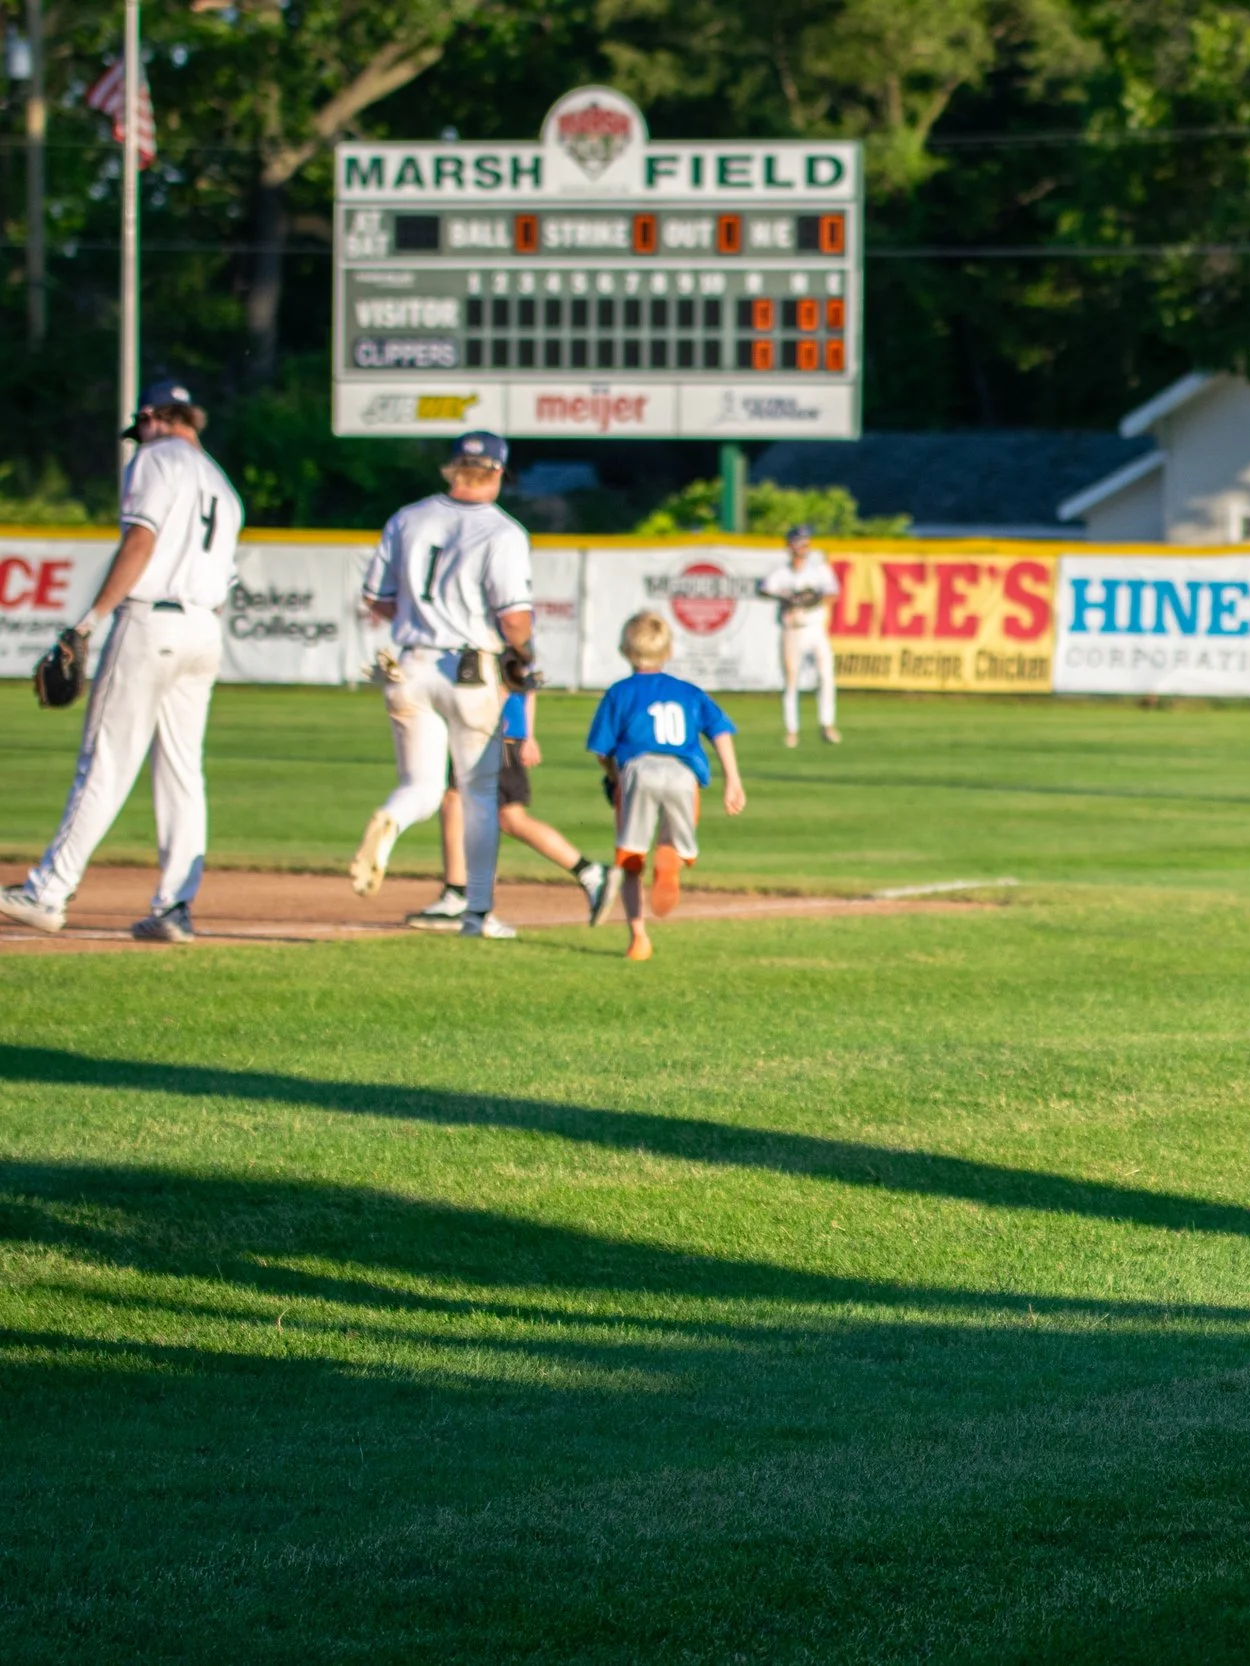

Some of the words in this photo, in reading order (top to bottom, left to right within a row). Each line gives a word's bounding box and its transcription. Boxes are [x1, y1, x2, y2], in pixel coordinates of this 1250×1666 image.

[344, 155, 542, 188] MARSH
[645, 155, 845, 188] FIELD
[450, 218, 509, 248] BALL
[543, 217, 629, 249] STRIKE
[663, 217, 714, 249] OUT
[492, 272, 508, 295] 2
[518, 272, 535, 295] 3
[545, 272, 562, 295] 4
[570, 272, 587, 295] 5
[625, 272, 641, 295] 7
[355, 297, 459, 328] VISITOR
[355, 338, 457, 368] CLIPPERS
[533, 383, 648, 432] meijer
[200, 492, 218, 554] 4
[230, 583, 313, 611] Baker
[830, 561, 1051, 641] LEE'S
[229, 615, 338, 646] College
[900, 650, 963, 680] Recipe
[975, 651, 1049, 681] Chicken
[647, 701, 686, 746] 10
